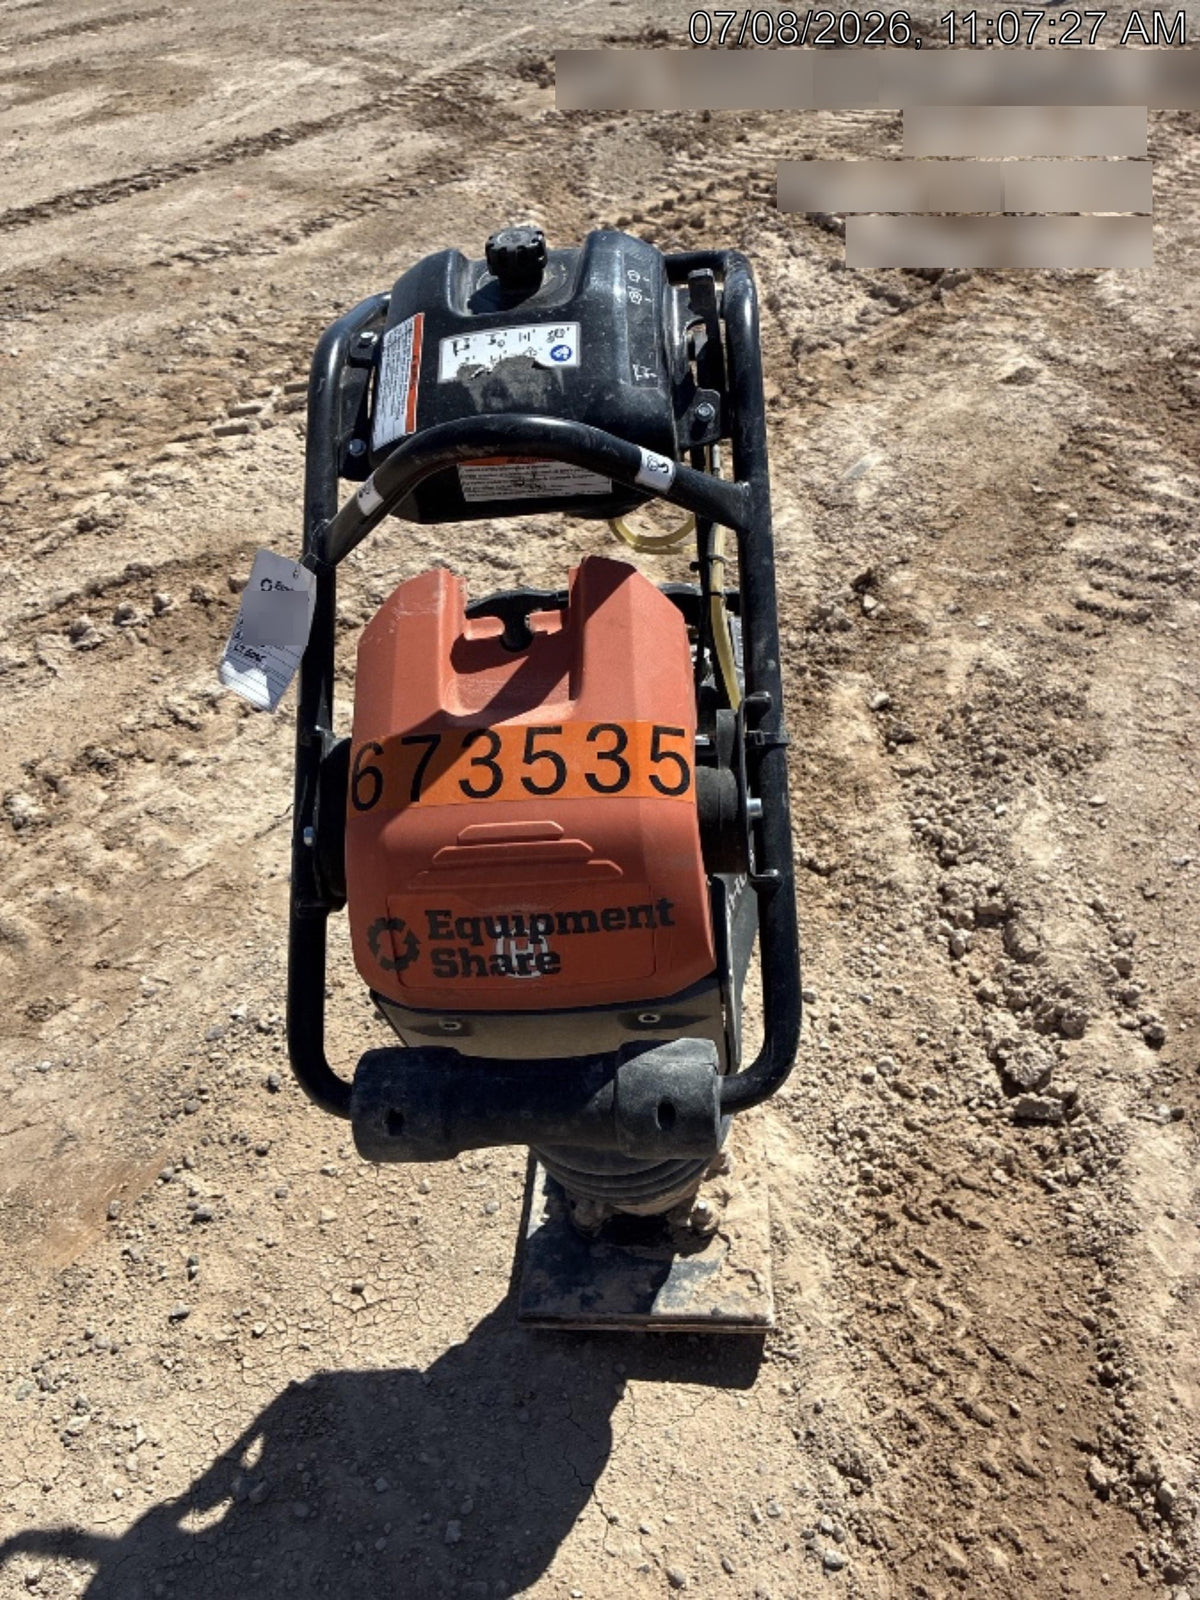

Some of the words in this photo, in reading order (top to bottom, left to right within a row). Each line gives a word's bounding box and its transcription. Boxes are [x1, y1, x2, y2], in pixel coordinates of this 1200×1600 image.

[351, 723, 691, 812] 673535
[425, 897, 675, 946] Equipment
[430, 948, 561, 978] Share
